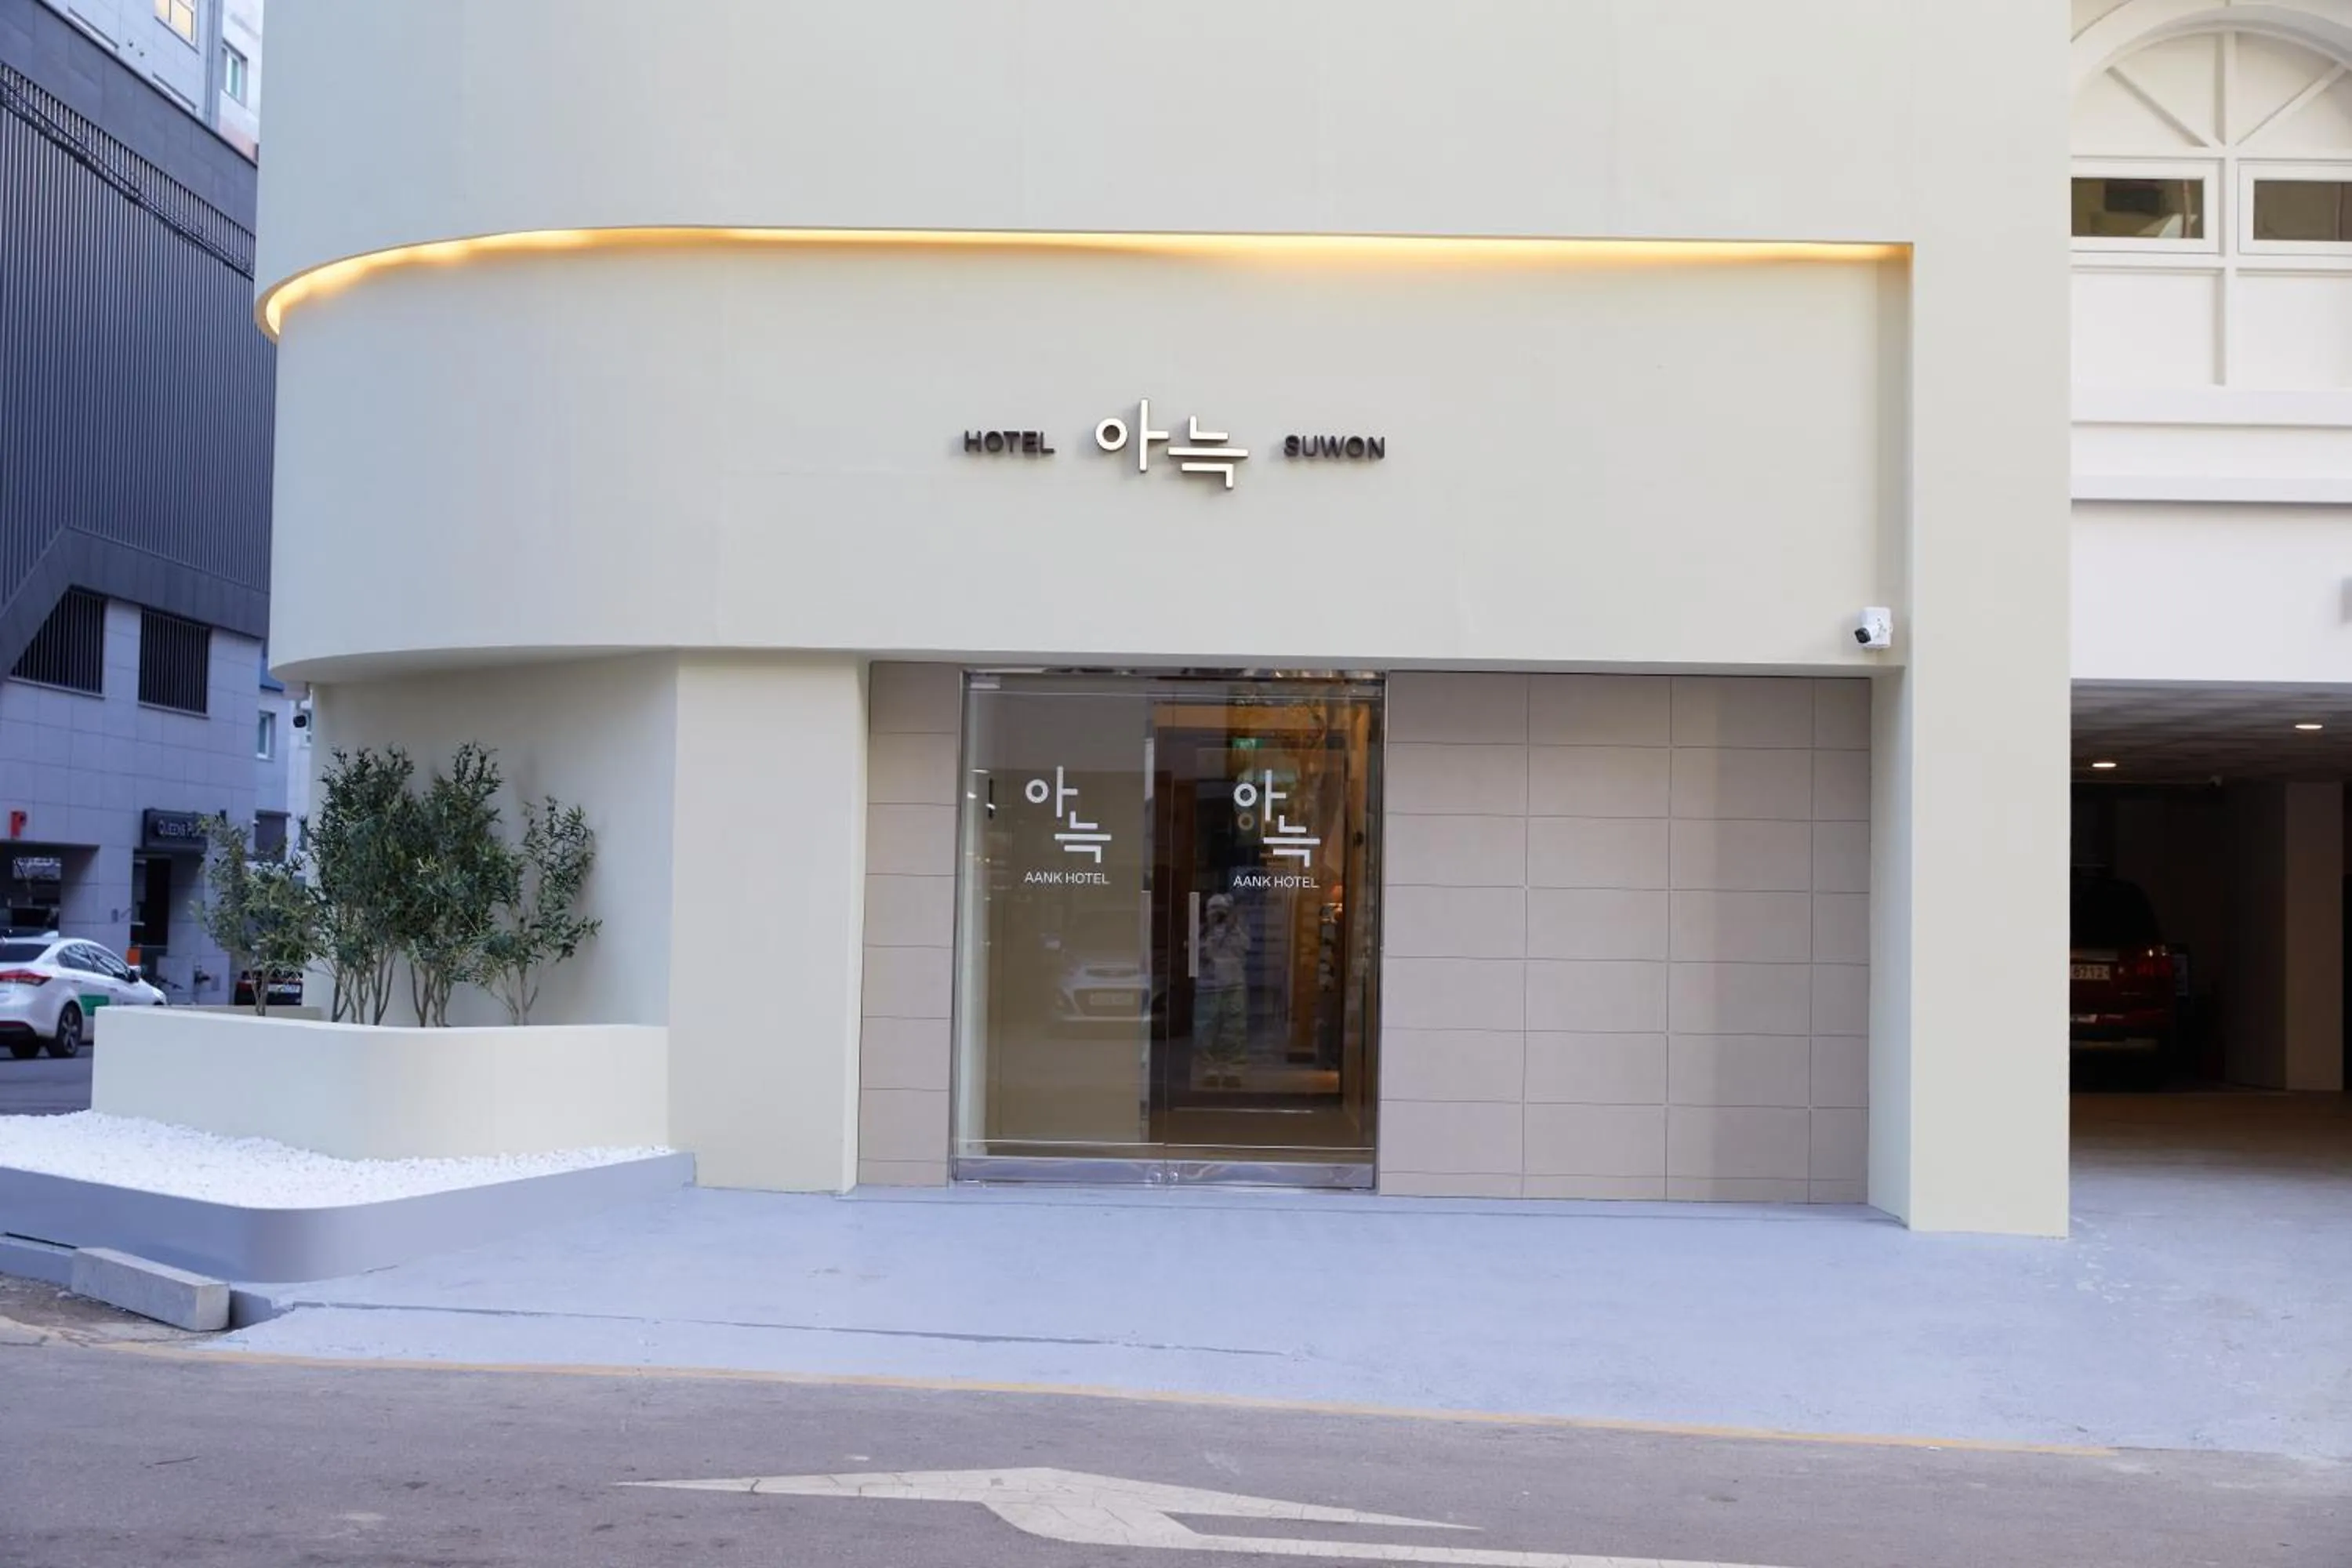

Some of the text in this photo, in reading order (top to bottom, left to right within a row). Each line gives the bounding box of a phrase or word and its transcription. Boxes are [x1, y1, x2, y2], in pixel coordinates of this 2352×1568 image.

[964, 430, 1055, 455] HOTEL
[1095, 398, 1248, 489] 아늑
[1283, 434, 1385, 459] SUWON
[1025, 765, 1112, 863] 아늑
[1233, 769, 1321, 868] 아늑
[1024, 871, 1110, 885] AANK HOTEL
[1233, 874, 1320, 889] AANK HOTEL
